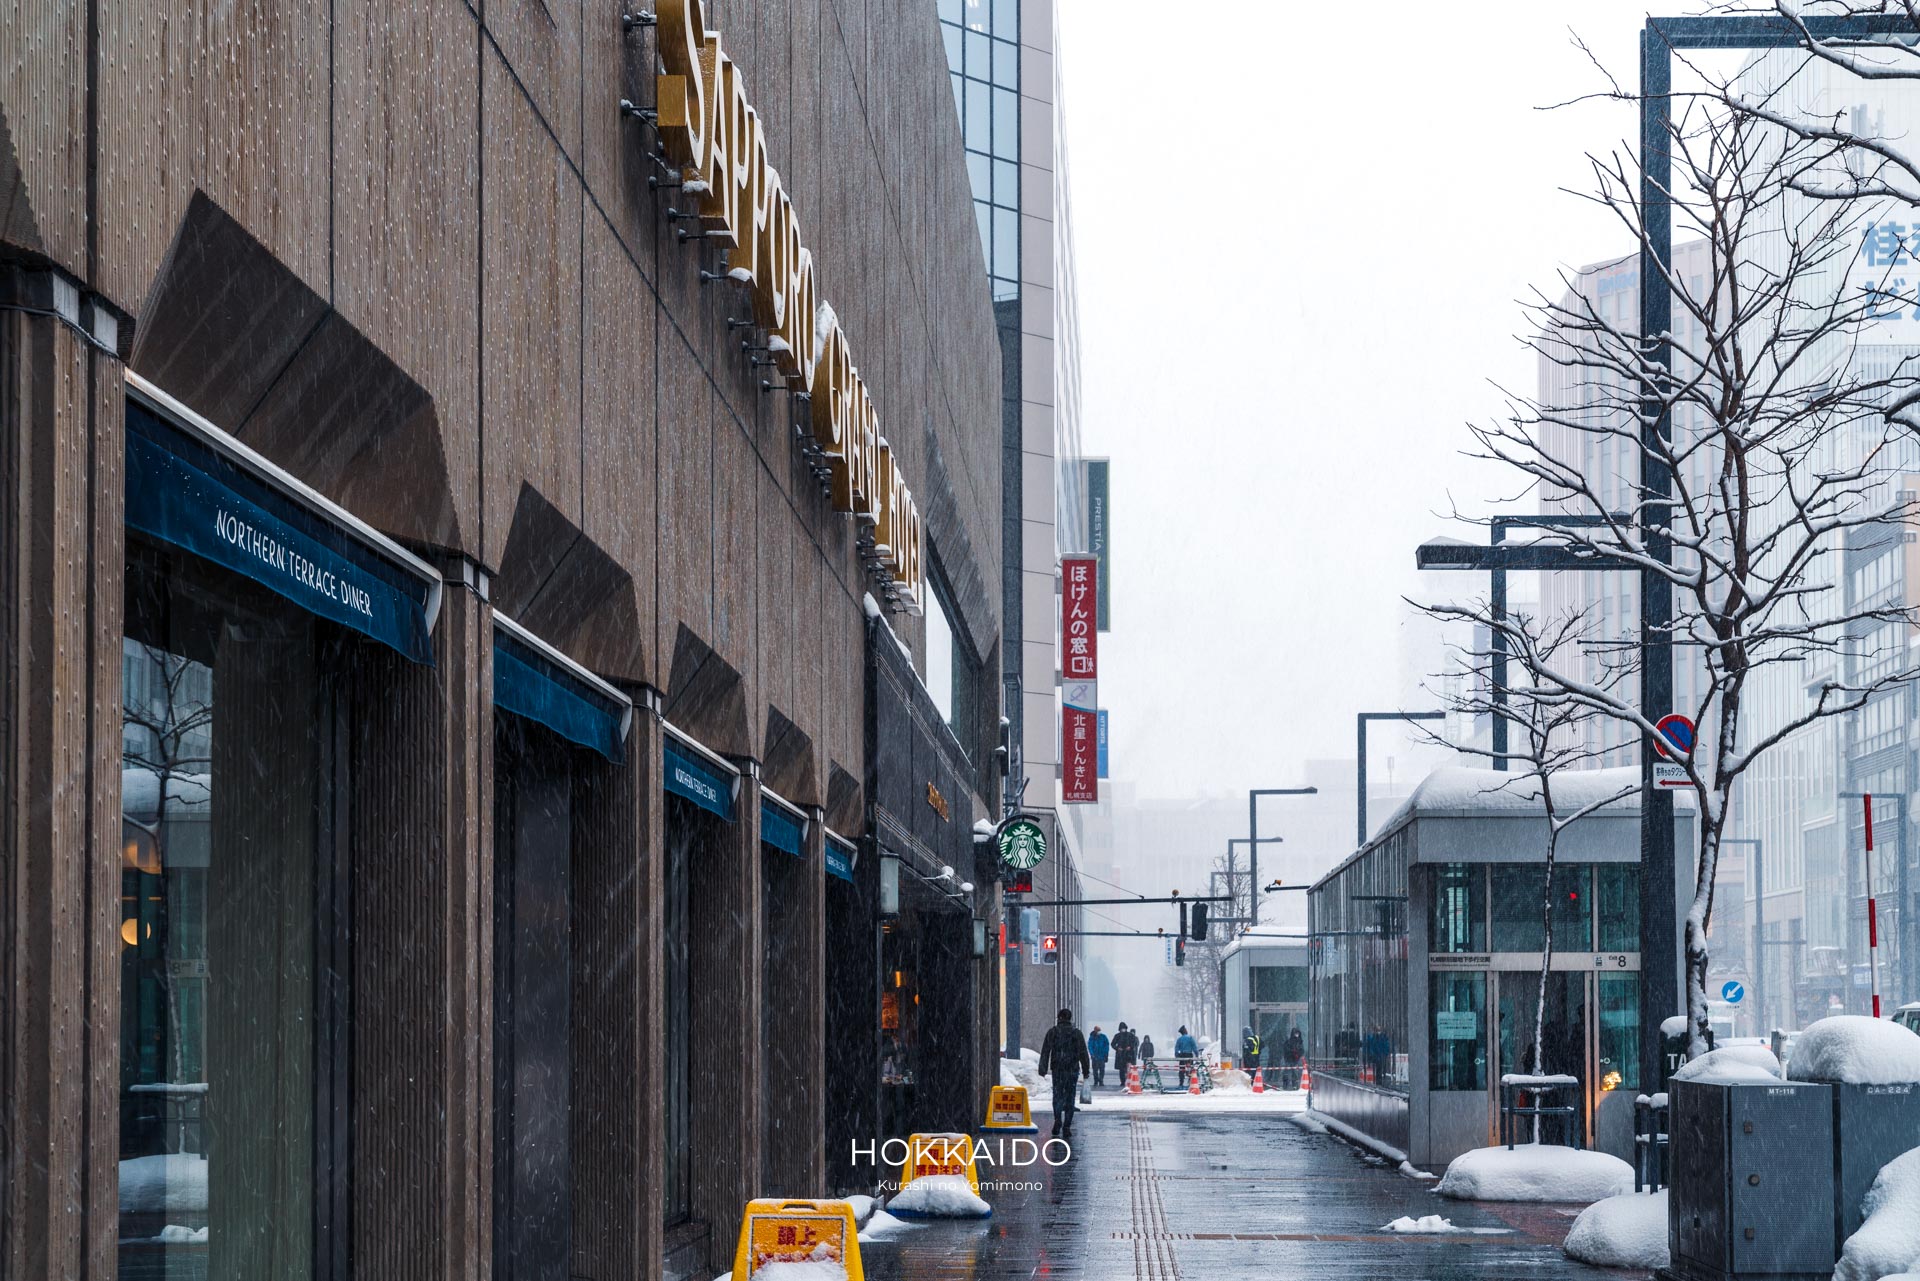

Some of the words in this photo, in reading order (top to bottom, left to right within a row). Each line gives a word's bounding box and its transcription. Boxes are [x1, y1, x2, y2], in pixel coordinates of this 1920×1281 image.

[658, 0, 816, 393] SAPPORO
[815, 316, 881, 526] GRAND
[1861, 221, 1920, 267] 桂
[1866, 278, 1920, 322] ビ
[216, 510, 286, 571] NORTHERN
[289, 551, 338, 600] TERRACE
[340, 580, 374, 618] DINER
[1070, 565, 1088, 673] ほけんの窓口
[1073, 714, 1087, 790] 北星しんきん
[1067, 792, 1093, 800] 札幌支店
[1618, 955, 1627, 968] 8
[777, 1225, 817, 1246] 頭上
